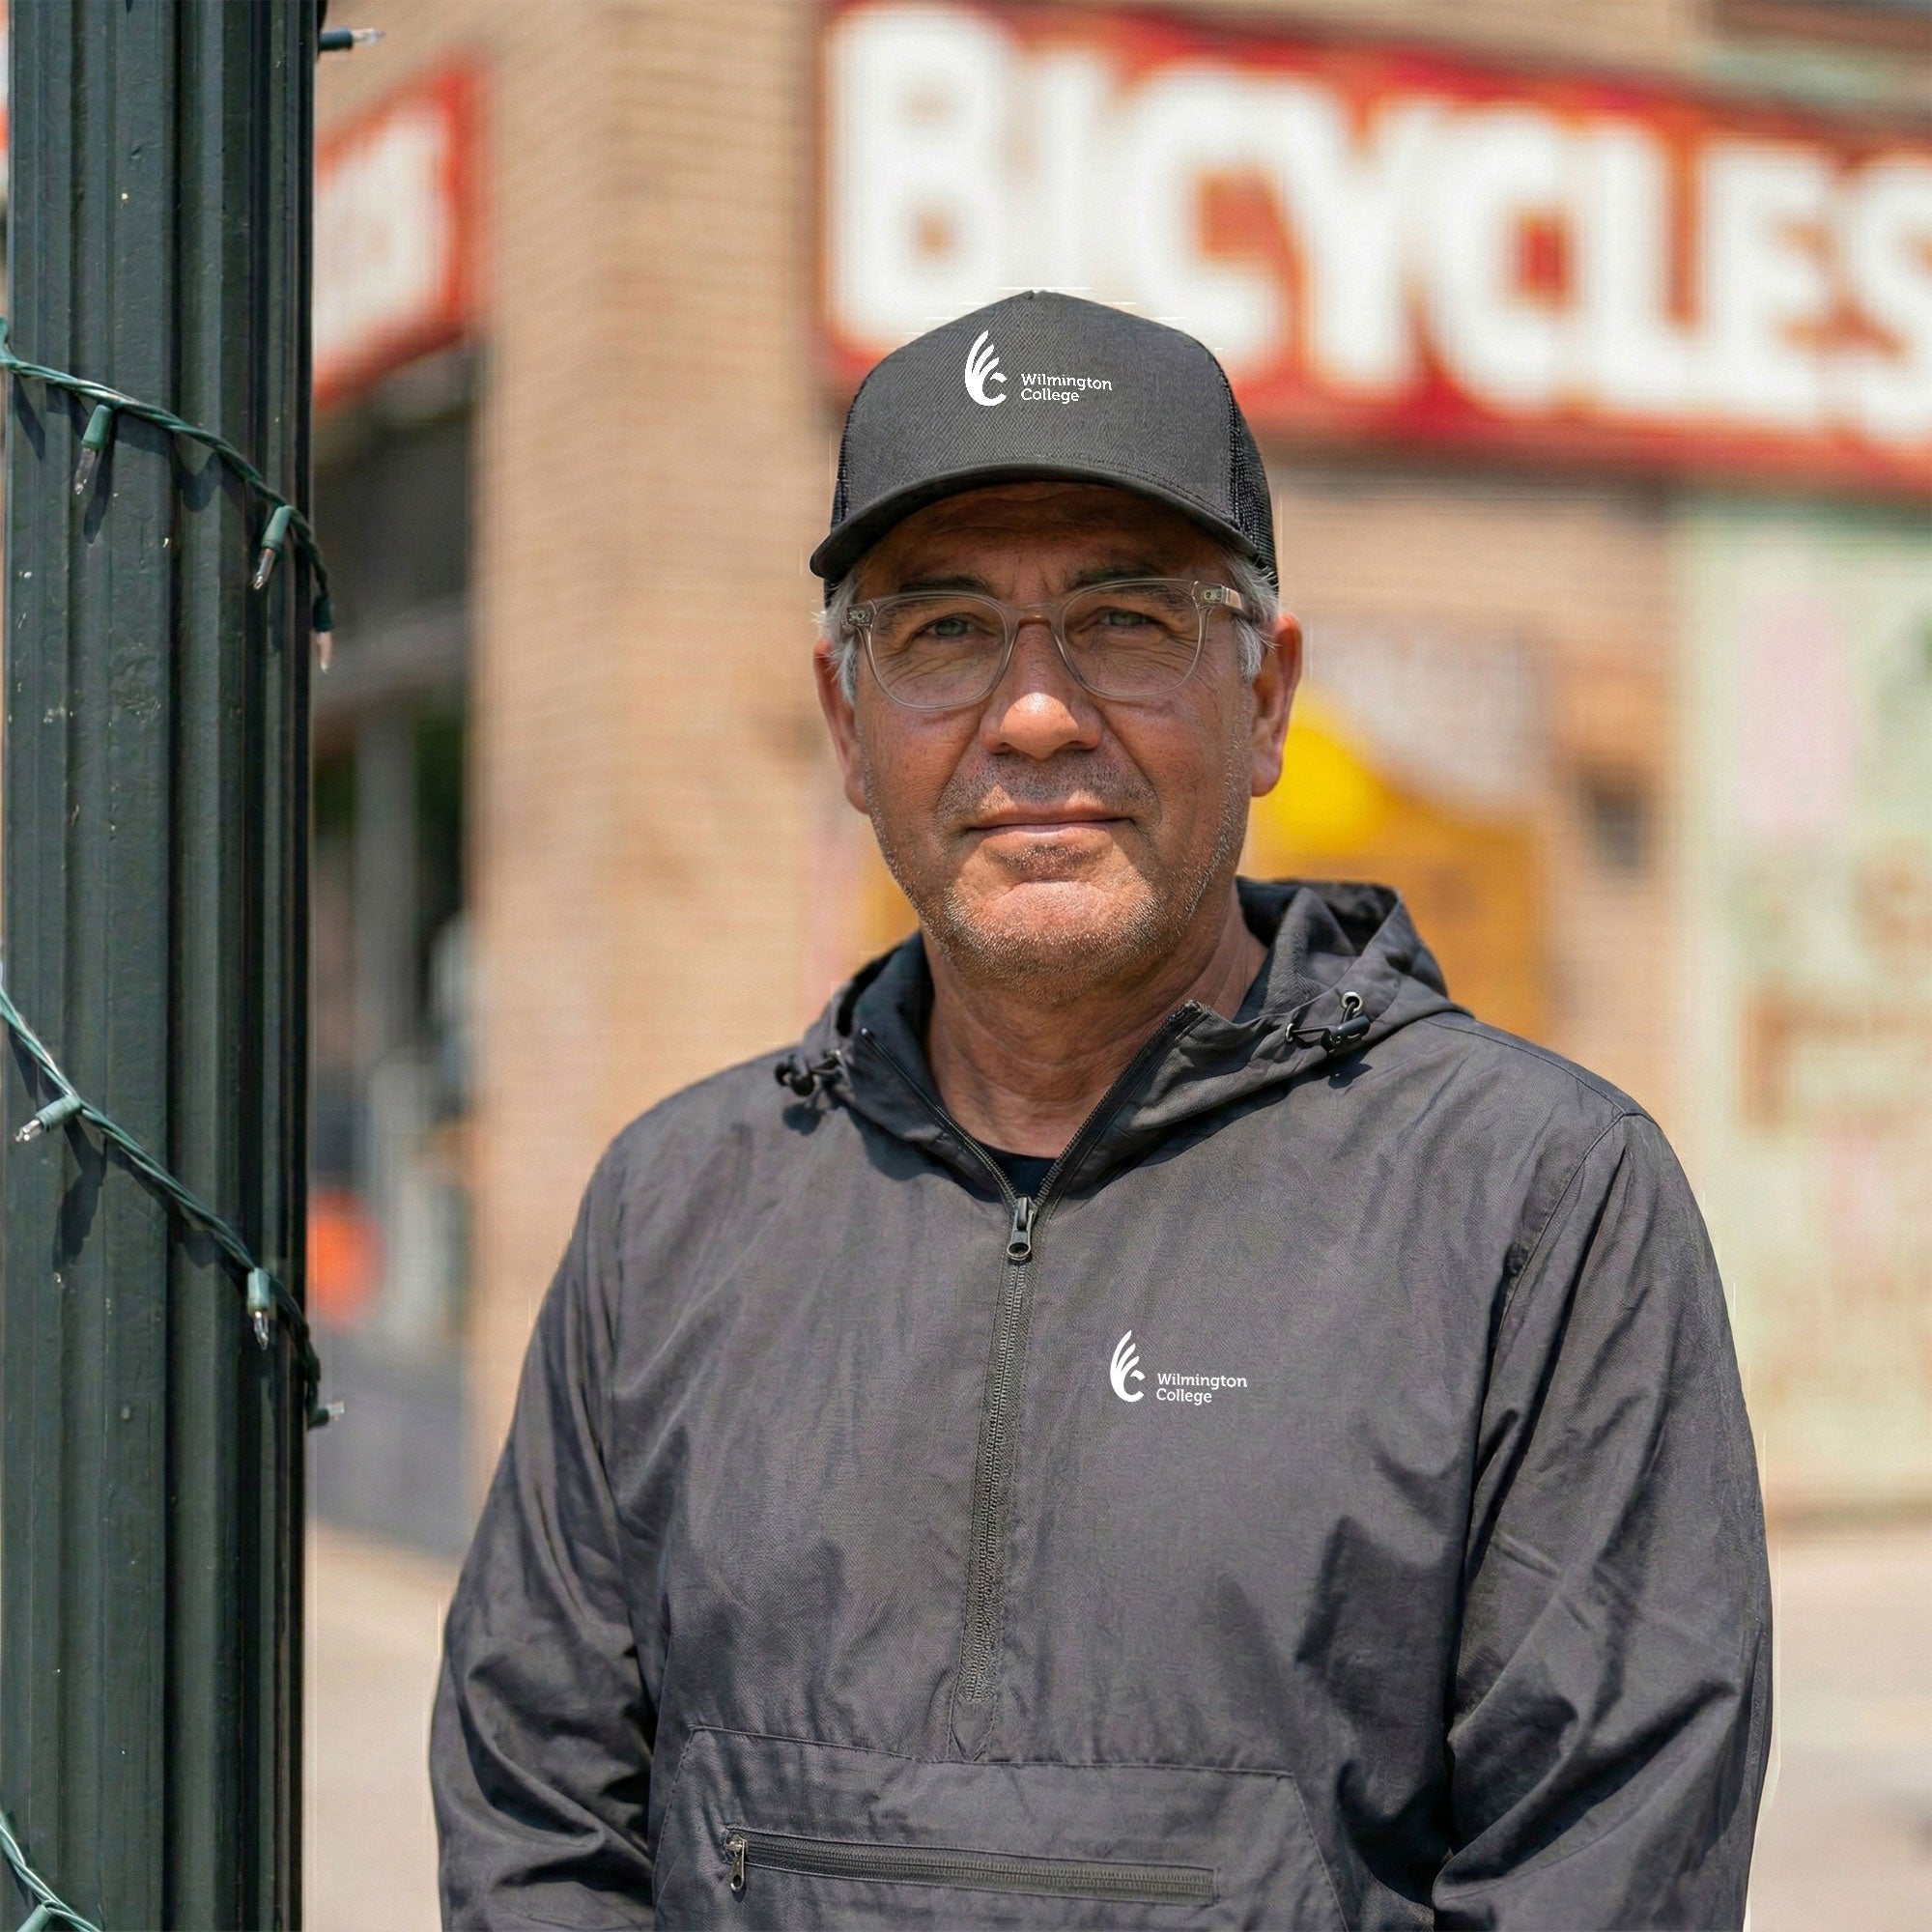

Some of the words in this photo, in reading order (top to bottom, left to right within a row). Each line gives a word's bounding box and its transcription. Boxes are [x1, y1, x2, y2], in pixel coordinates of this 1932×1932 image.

[827, 3, 1932, 442] BICYCLES
[1021, 373, 1113, 391] Wilmington
[1021, 388, 1080, 405] College
[1156, 1373, 1248, 1390] Wilmington
[1156, 1388, 1212, 1406] College
